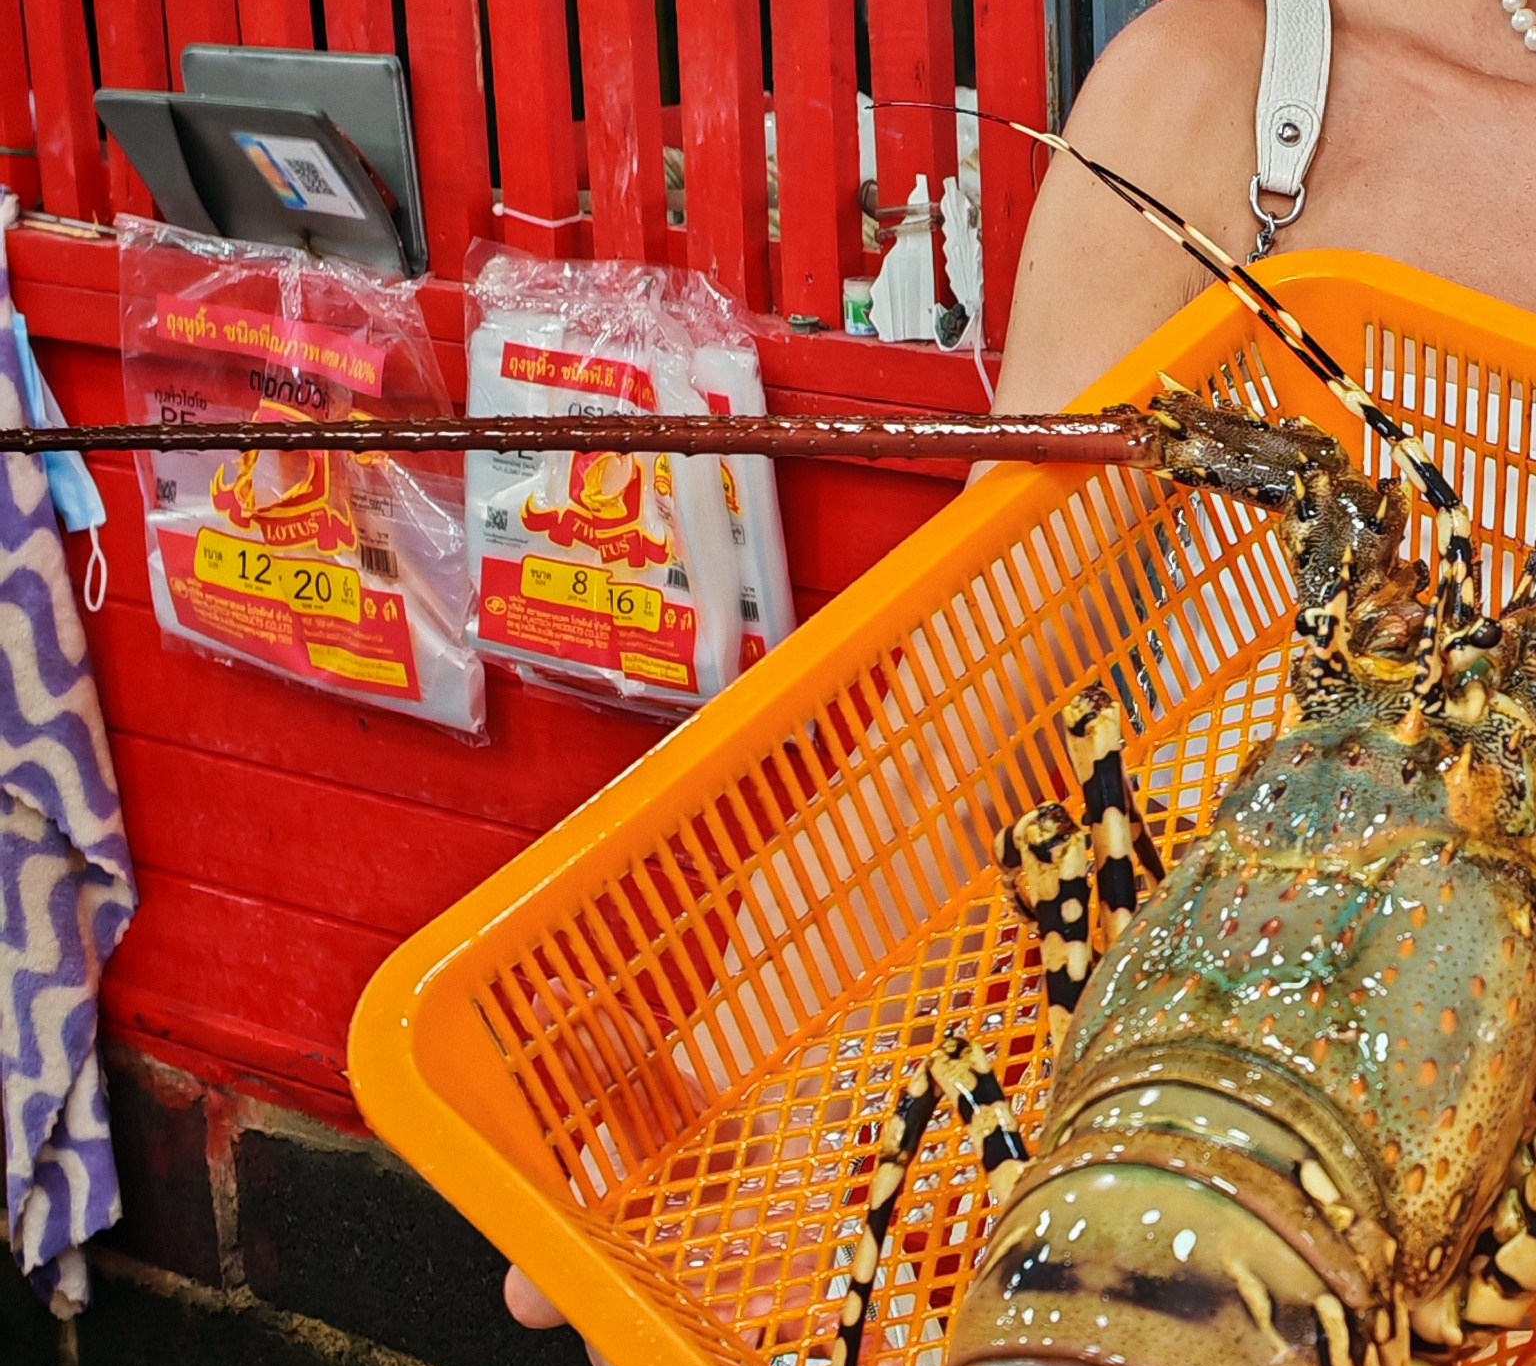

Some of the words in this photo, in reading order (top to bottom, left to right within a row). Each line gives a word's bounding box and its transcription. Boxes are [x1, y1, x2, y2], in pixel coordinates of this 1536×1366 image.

[509, 352, 556, 381] ถุงหูหิ้ว
[266, 517, 320, 542] LOTUS
[237, 549, 272, 585] 12
[293, 569, 332, 603] 20
[571, 570, 588, 595] 8
[607, 588, 635, 615] 16
